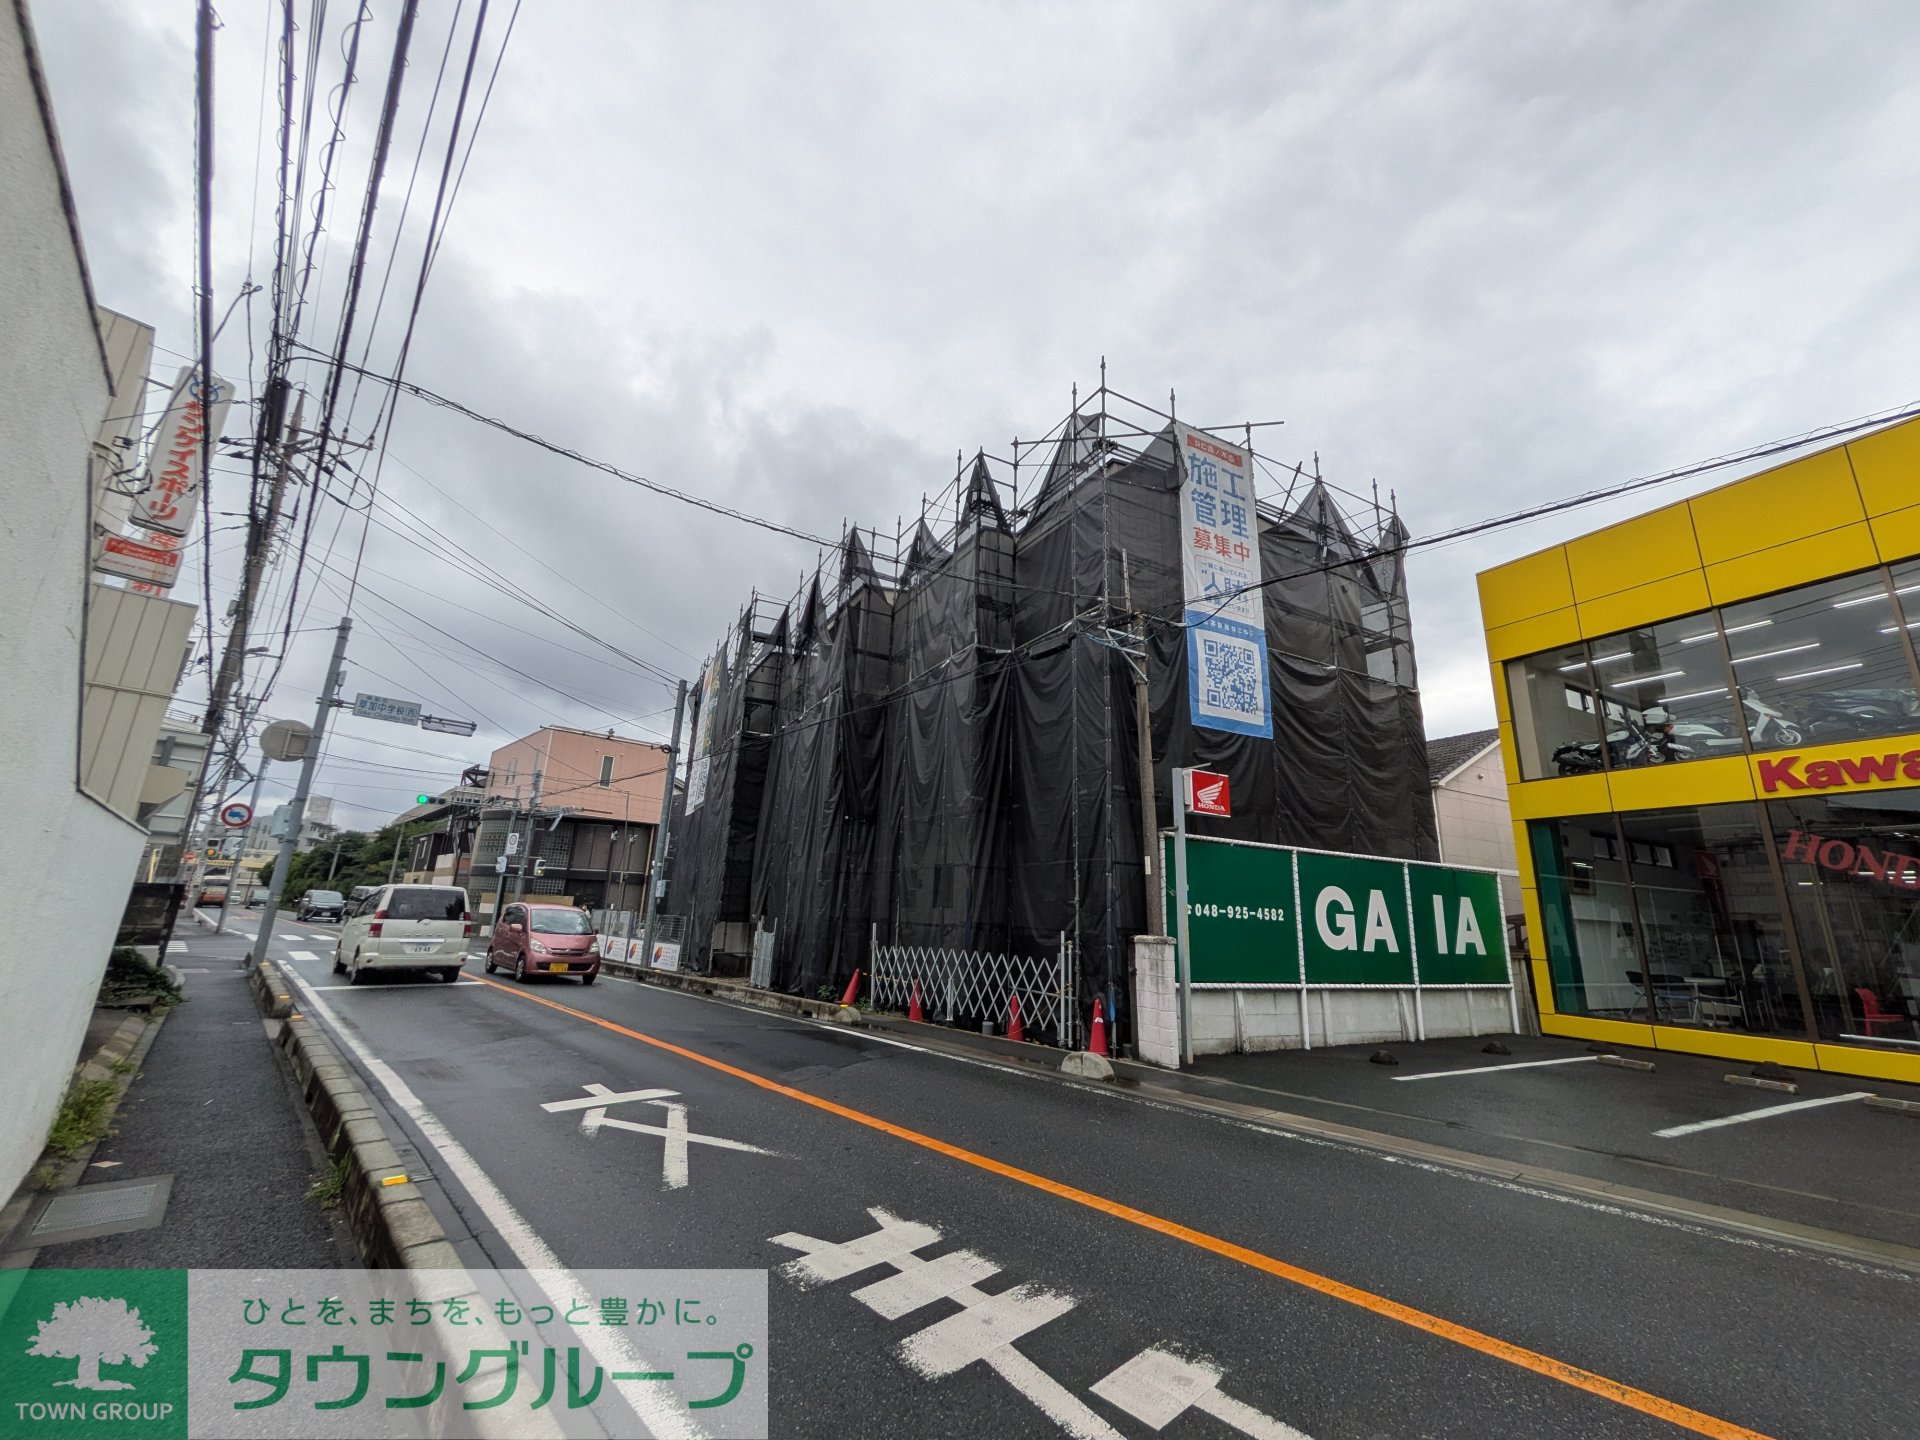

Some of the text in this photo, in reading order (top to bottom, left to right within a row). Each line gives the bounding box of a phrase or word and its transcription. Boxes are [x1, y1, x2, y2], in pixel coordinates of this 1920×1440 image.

[1187, 452, 1246, 502] 施工
[1190, 487, 1250, 539] 管理
[1193, 526, 1251, 562] 募集中
[1197, 802, 1226, 812] HONDA
[1195, 904, 1285, 922] 048-925-4582
